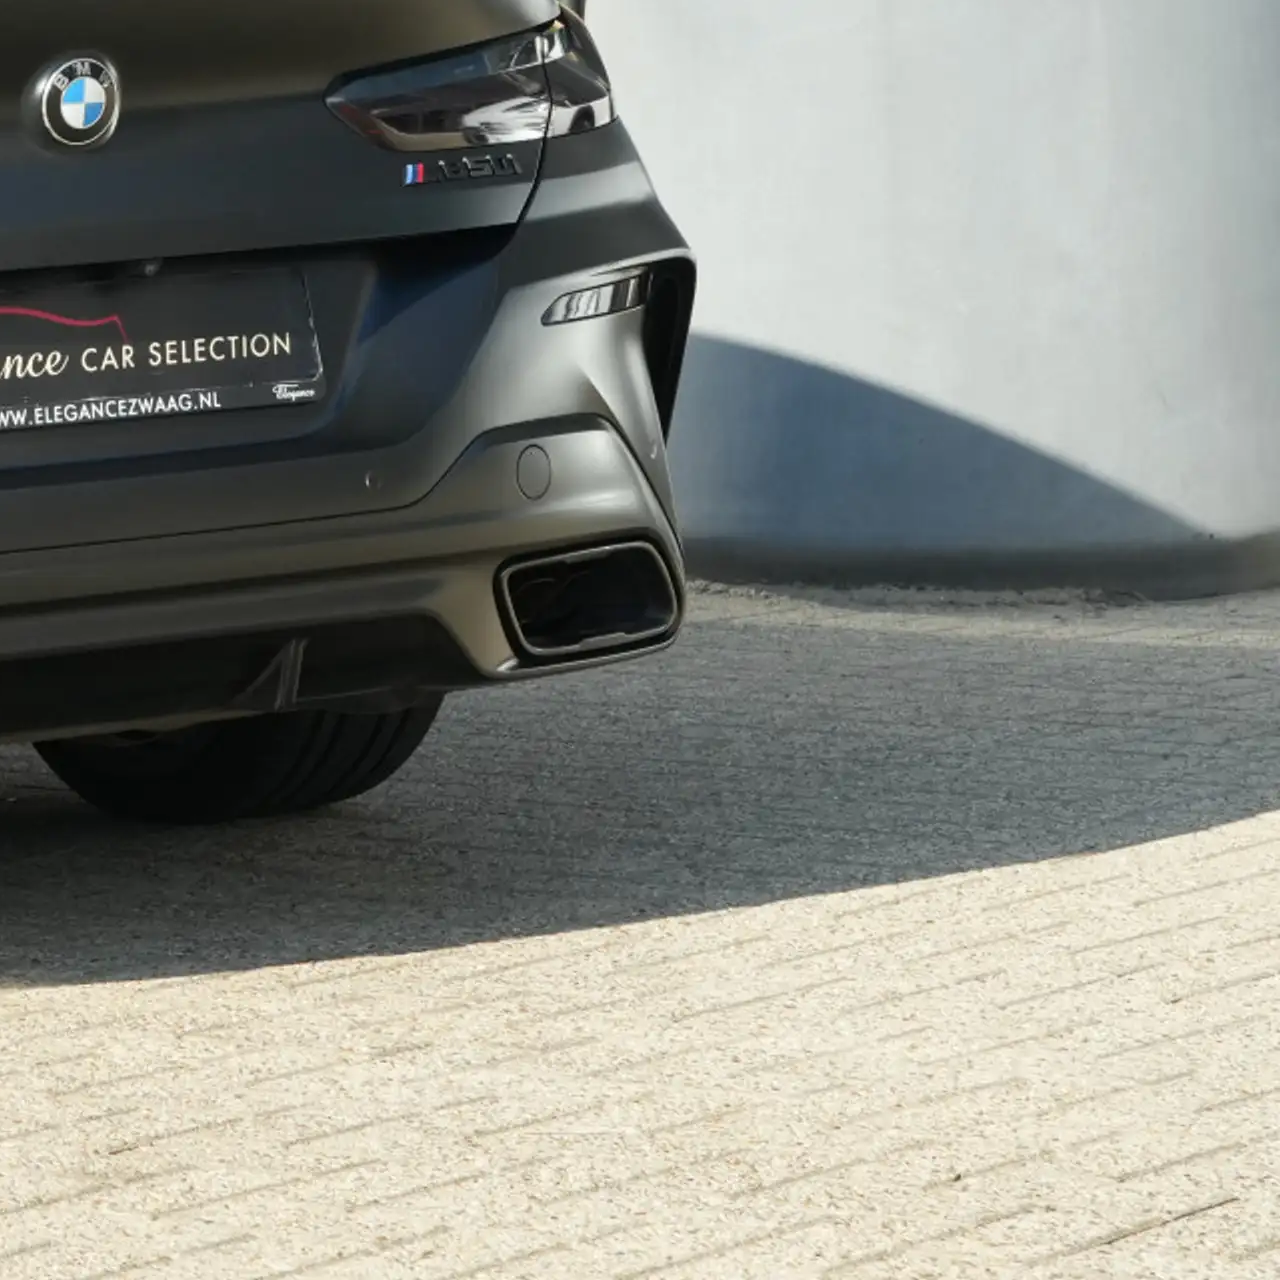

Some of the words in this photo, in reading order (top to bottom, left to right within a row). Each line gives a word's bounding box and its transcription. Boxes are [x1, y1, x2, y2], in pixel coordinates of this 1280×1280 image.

[53, 61, 114, 92] BMW
[80, 339, 137, 373] CAR
[148, 331, 292, 368] SELECTION
